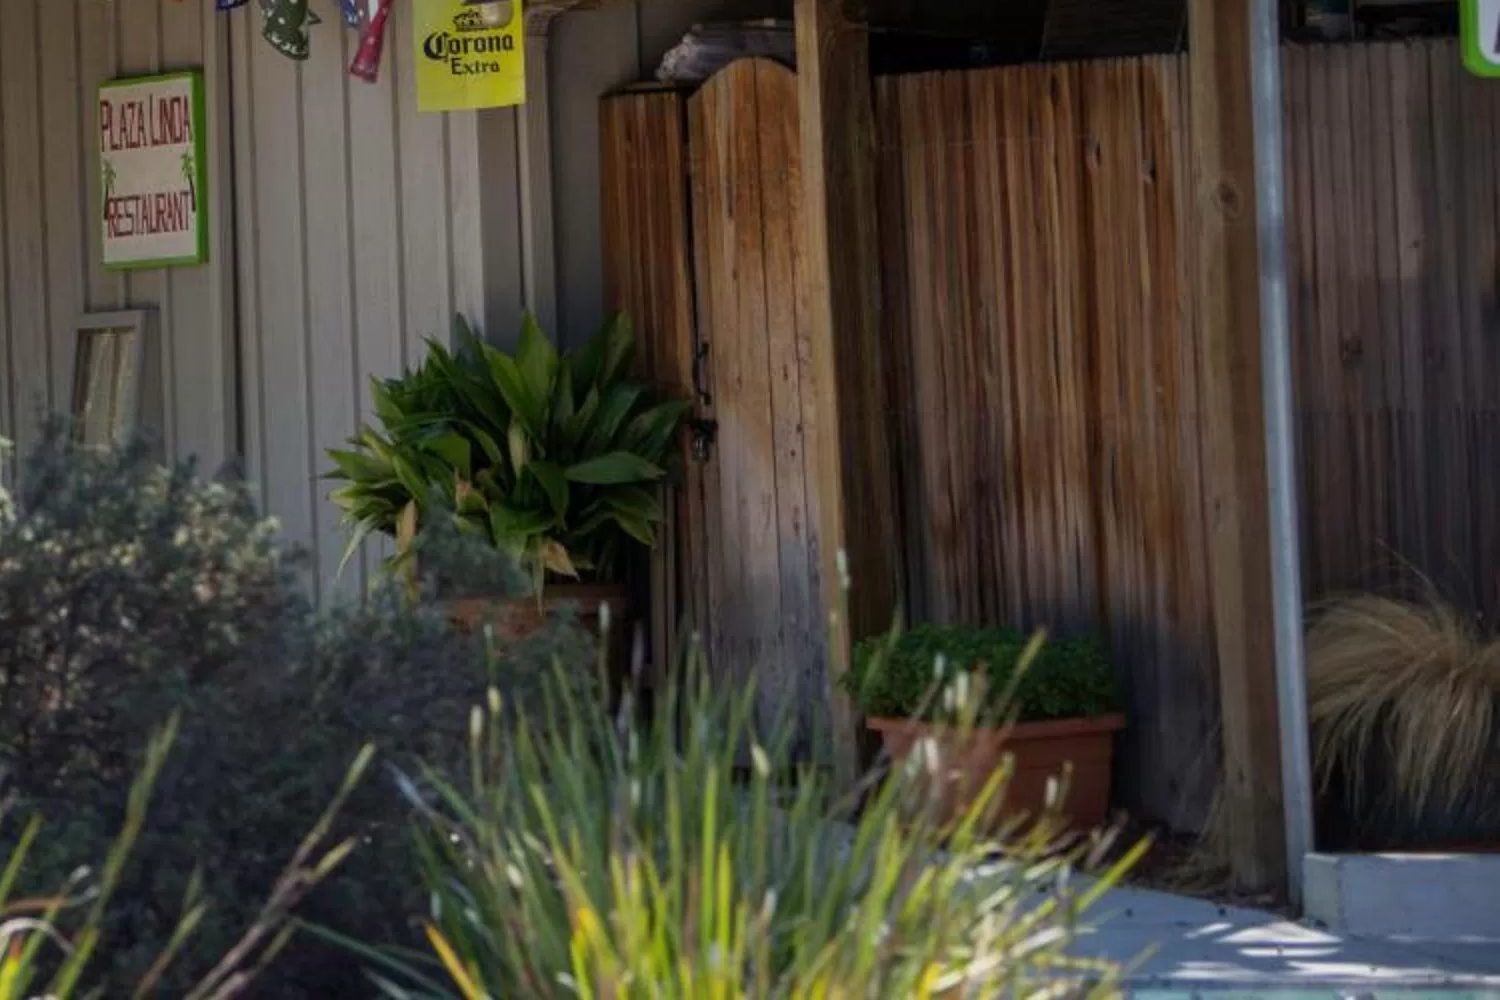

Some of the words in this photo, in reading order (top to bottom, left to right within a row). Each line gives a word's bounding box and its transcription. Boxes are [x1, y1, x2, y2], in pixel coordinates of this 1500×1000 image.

[423, 31, 516, 64] Corona
[451, 57, 501, 75] Extra
[100, 100, 148, 153] PLAZA
[149, 93, 193, 147] LINDA
[107, 191, 191, 240] RESTAURANT
